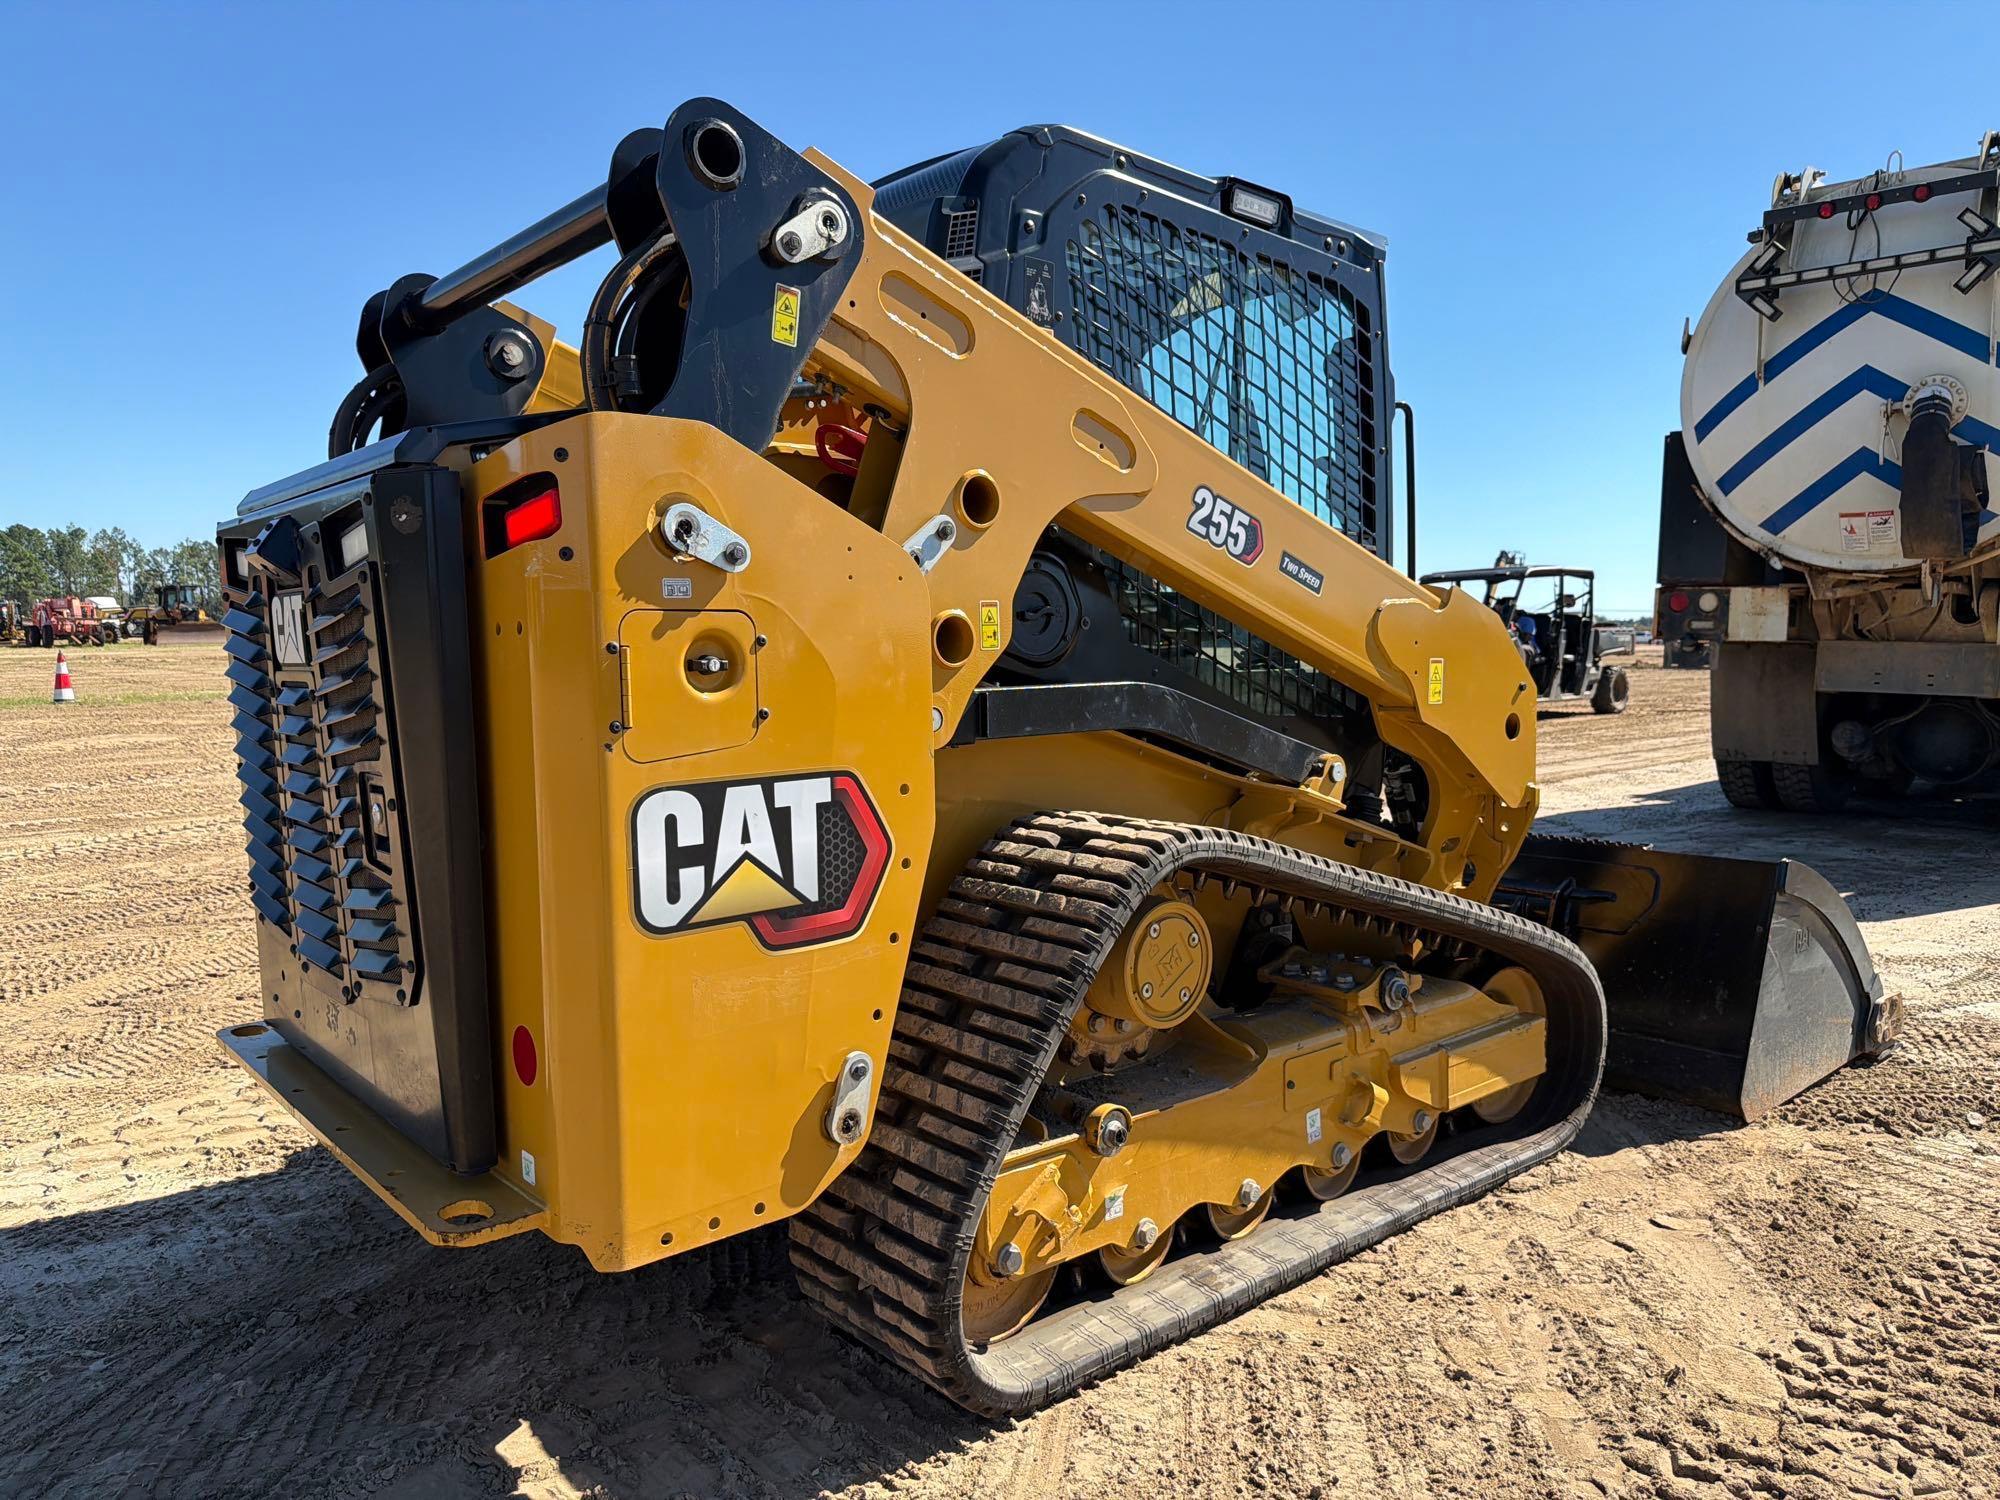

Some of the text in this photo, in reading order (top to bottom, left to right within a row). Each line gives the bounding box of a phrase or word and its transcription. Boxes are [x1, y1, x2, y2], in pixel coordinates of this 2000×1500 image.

[1188, 488, 1250, 555] 255
[271, 594, 306, 664] CAT
[636, 777, 832, 928] CAT
